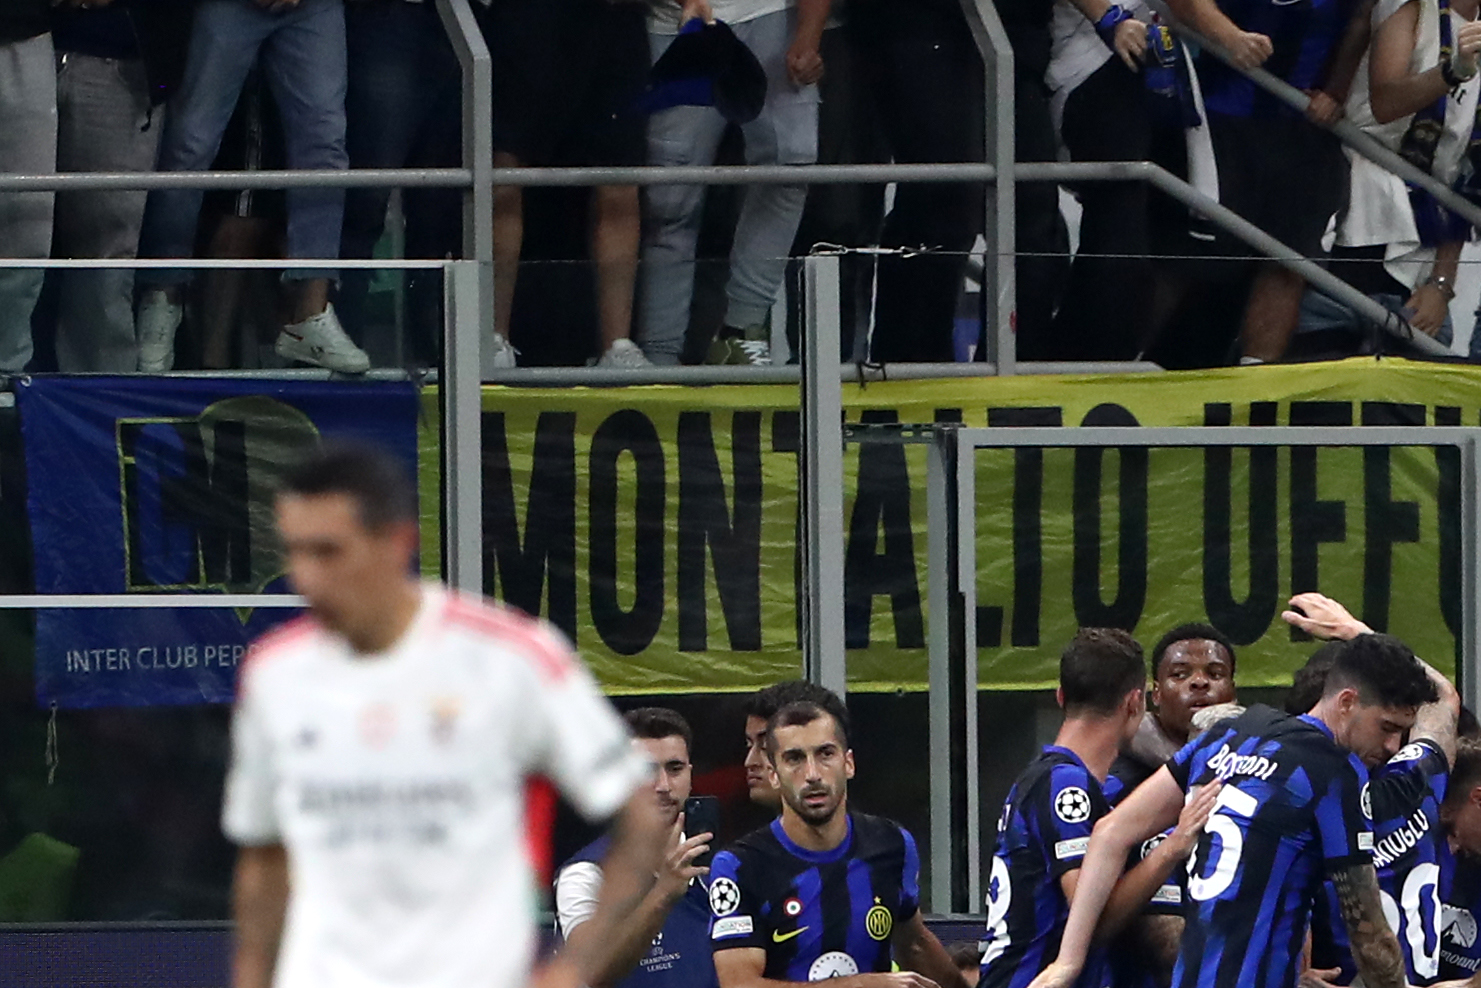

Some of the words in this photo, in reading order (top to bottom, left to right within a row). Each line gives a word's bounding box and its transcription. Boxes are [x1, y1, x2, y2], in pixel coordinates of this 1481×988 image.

[480, 402, 1149, 655] MONATO
[67, 646, 131, 672] INTER
[137, 645, 198, 669] CLUB
[1185, 783, 1259, 901] 5
[1372, 808, 1430, 868] ANOGLU
